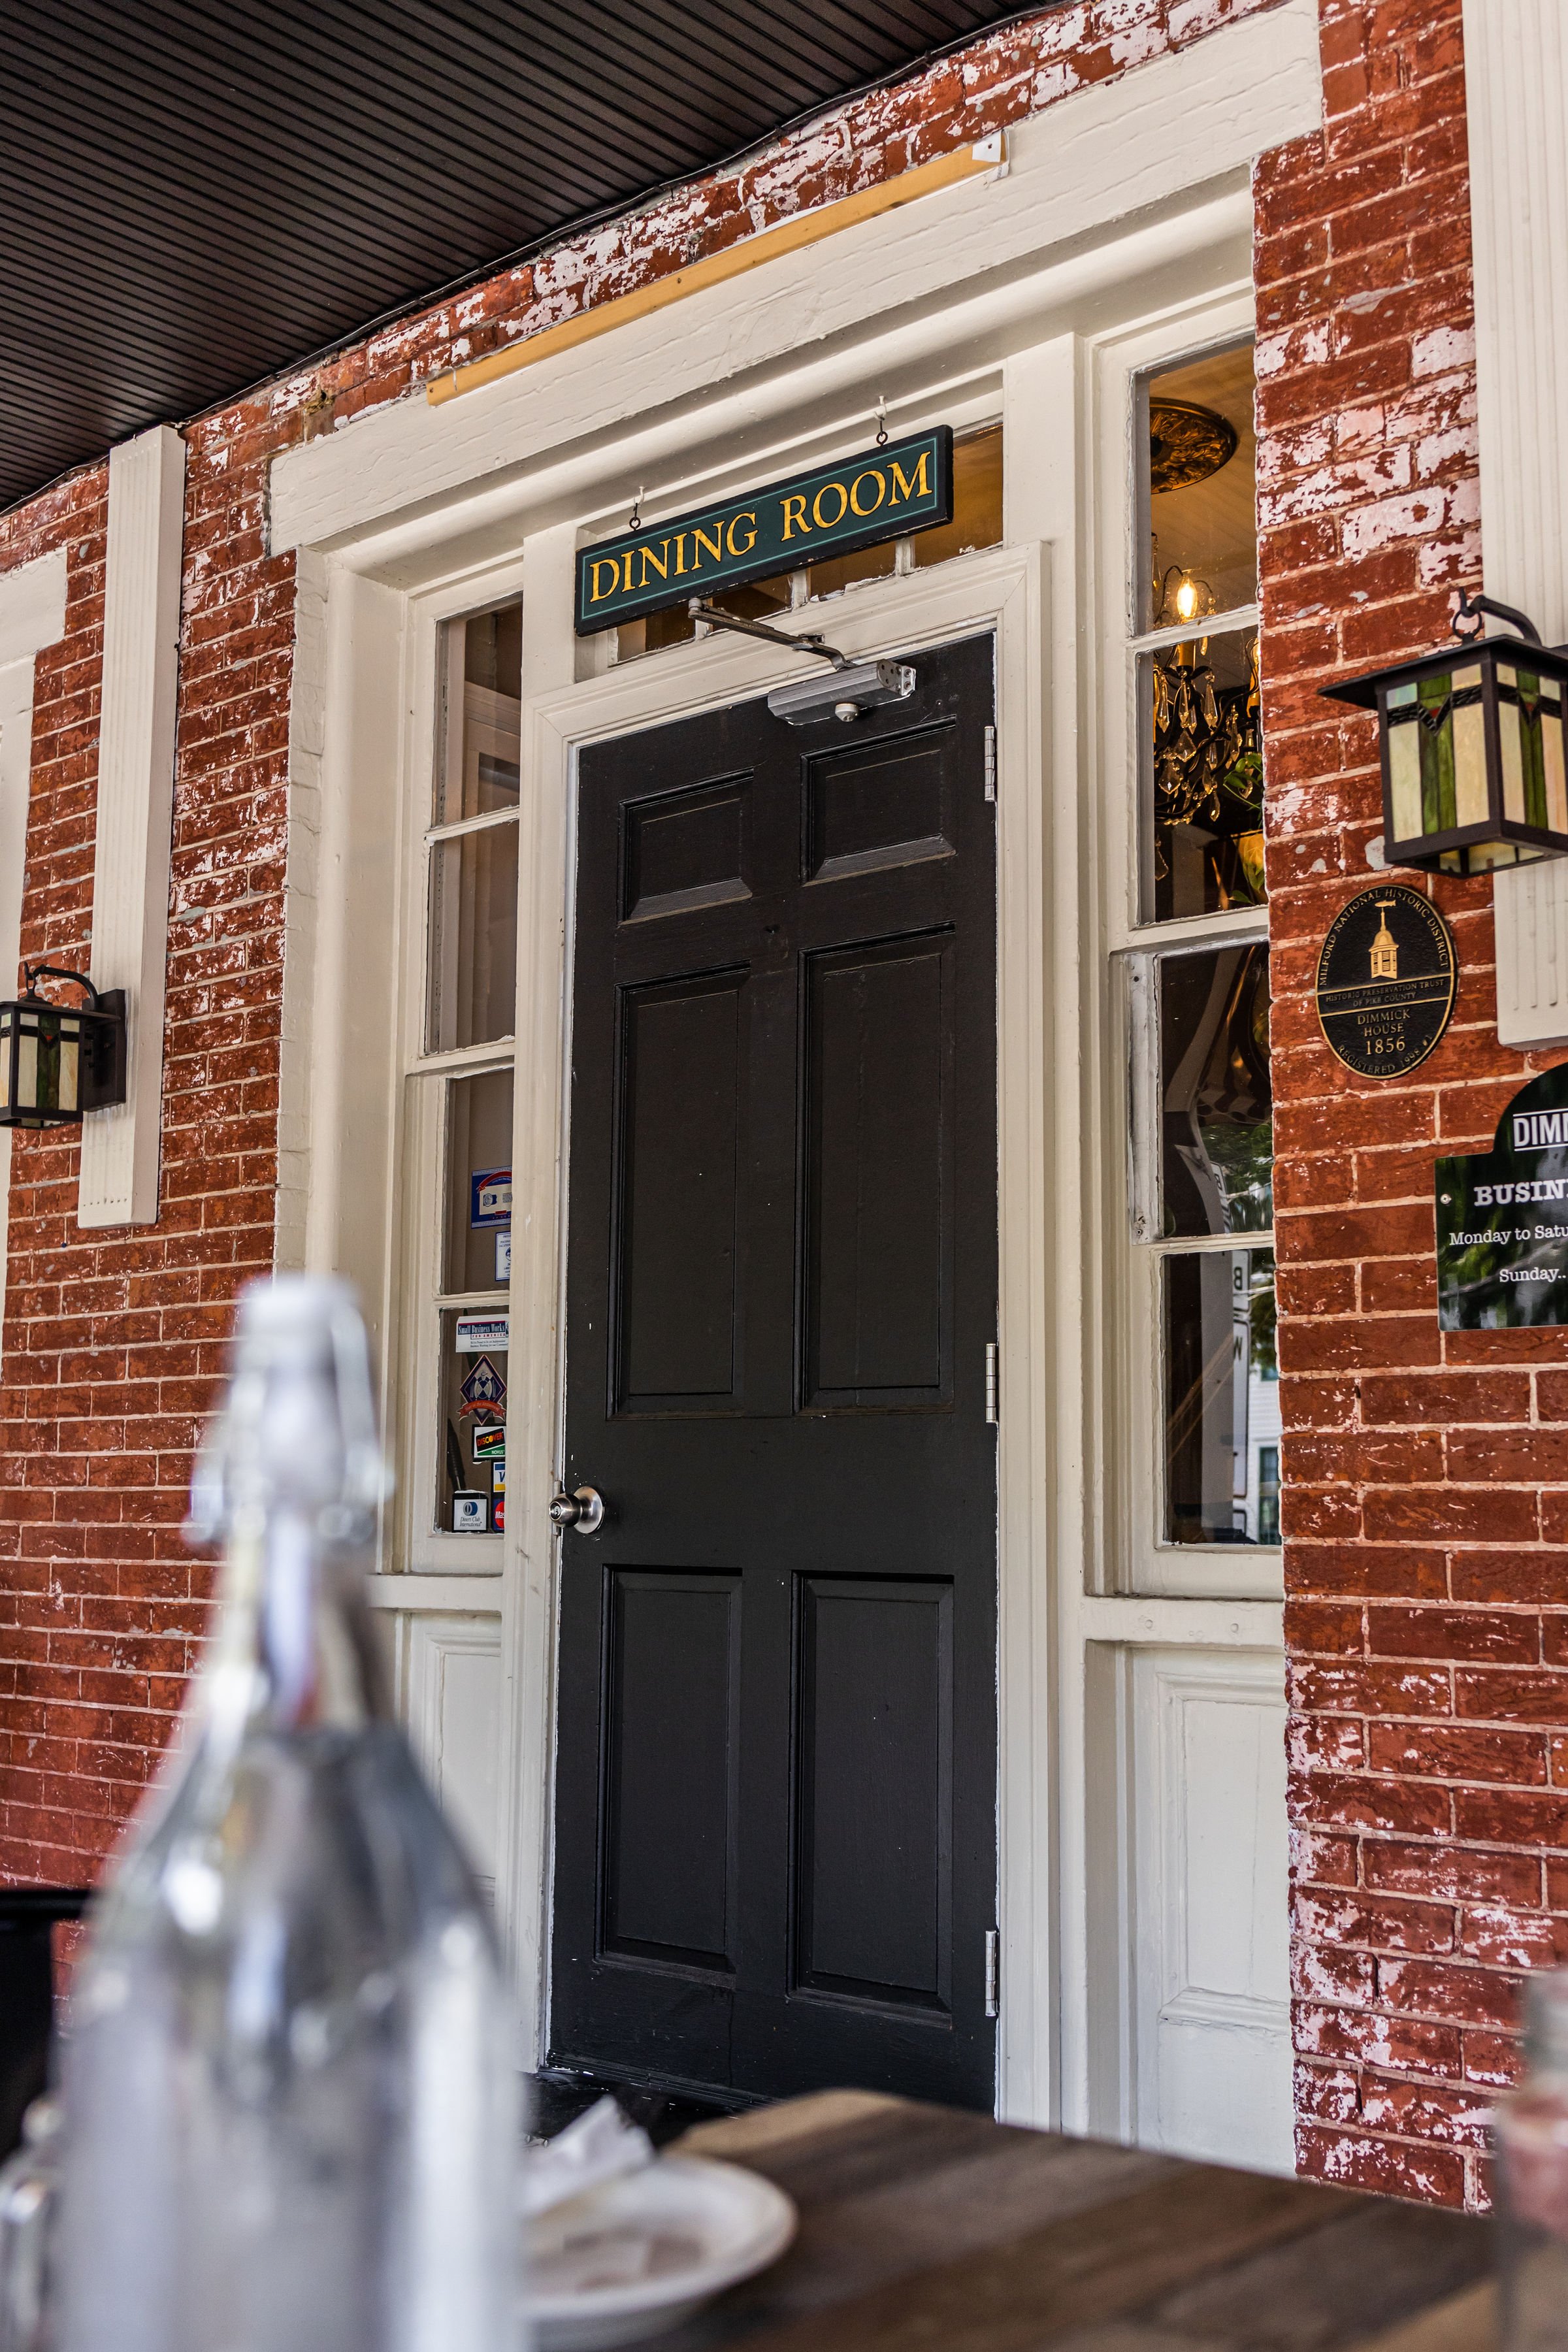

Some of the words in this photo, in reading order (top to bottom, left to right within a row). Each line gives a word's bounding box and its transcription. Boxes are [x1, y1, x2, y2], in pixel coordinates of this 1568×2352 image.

[589, 512, 759, 603] DINING
[779, 451, 933, 542] ROOM
[1318, 934, 1337, 986] MILFORD
[1334, 889, 1381, 933] NATIONAL
[1384, 889, 1430, 918] HISTORIC
[1427, 917, 1449, 968] DISTRICT
[1325, 992, 1360, 1003] HISTORIC
[1362, 983, 1417, 998] PRESERVATION
[1419, 979, 1445, 989] TRUST
[1352, 999, 1363, 1007] OF
[1365, 996, 1382, 1005] PIKE
[1384, 992, 1417, 1004] COUNTY
[1357, 1008, 1411, 1026] DIMMICK
[1364, 1022, 1405, 1037] HOUSE
[1365, 1036, 1406, 1056] 1856
[1337, 1043, 1396, 1075] REGISTERED
[1400, 1047, 1421, 1069] 1998
[1448, 1229, 1512, 1245] Monday
[1514, 1228, 1531, 1241] to
[458, 1325, 471, 1334] Small
[472, 1324, 490, 1333] Business
[491, 1323, 505, 1332] Works
[477, 1431, 503, 1446] DISCOVER
